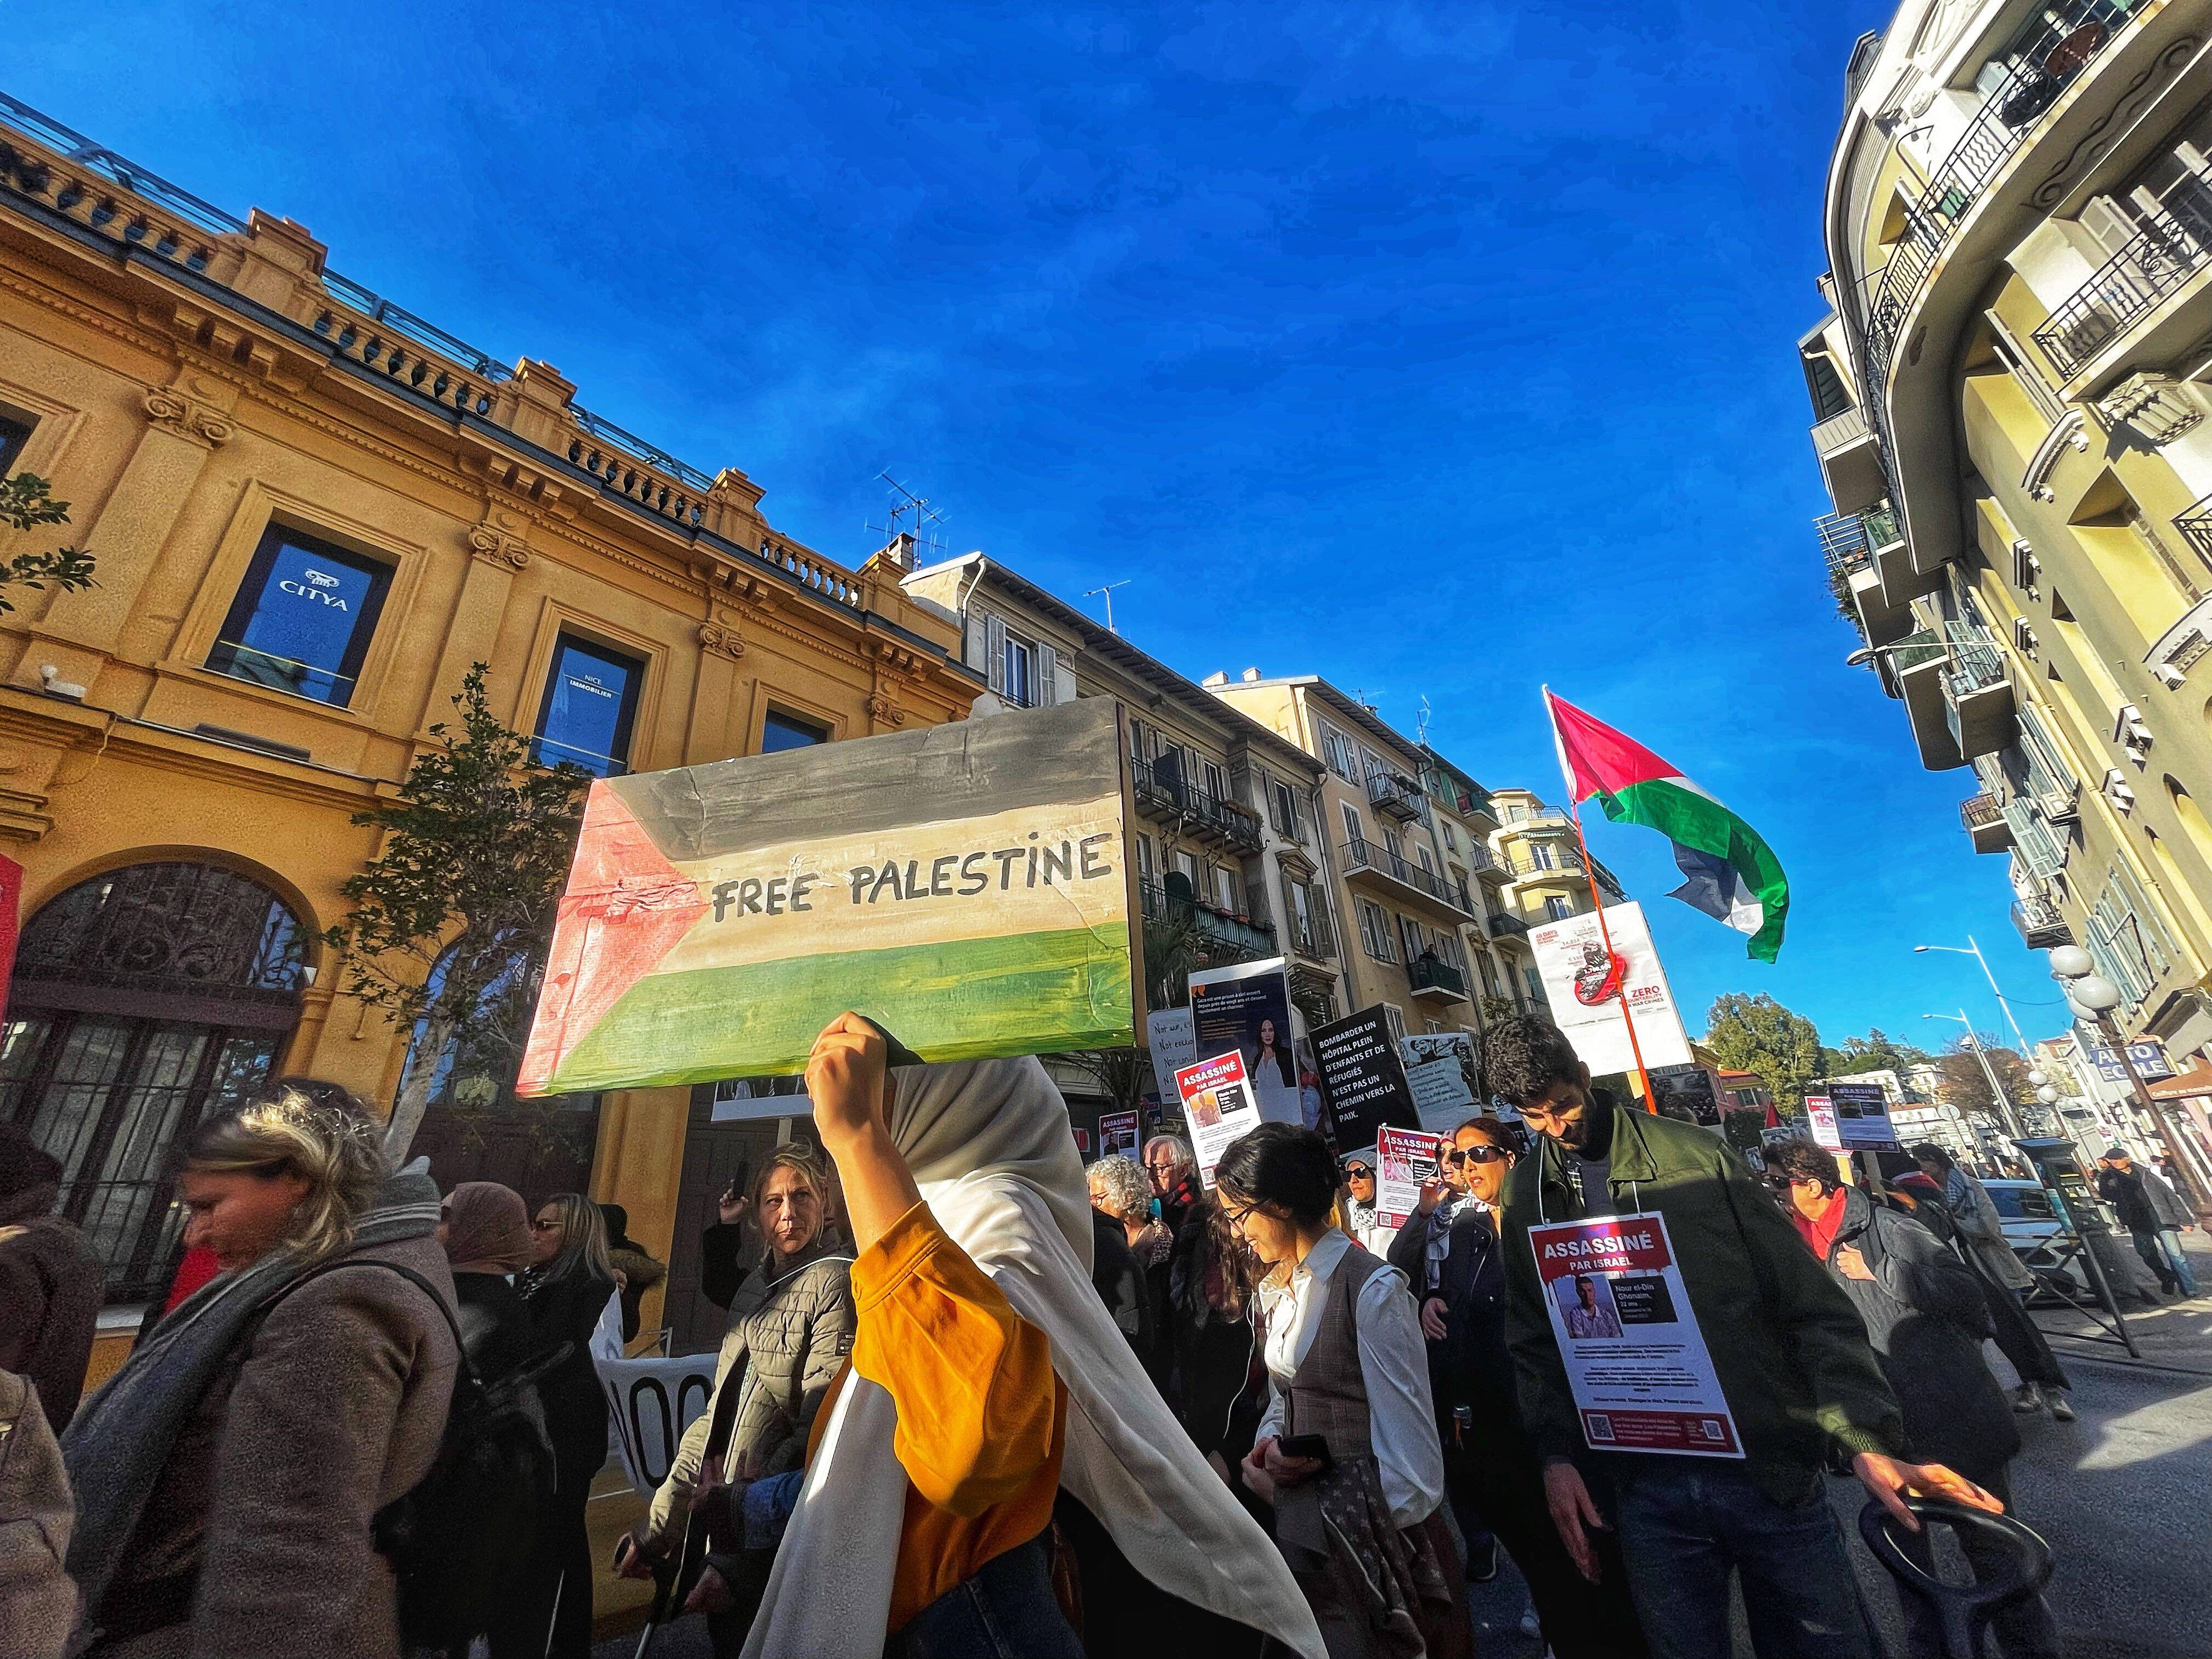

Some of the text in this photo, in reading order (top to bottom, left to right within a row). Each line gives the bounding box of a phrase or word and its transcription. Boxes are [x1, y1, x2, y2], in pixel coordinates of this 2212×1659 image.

[279, 579, 348, 612] CITYA
[569, 680, 612, 699] IMMOBILIER
[585, 674, 602, 686] NICE
[712, 873, 819, 923] FREE
[1631, 986, 1660, 997] ZERO
[1154, 1023, 1167, 1035] Not
[1319, 1020, 1376, 1048] BOMBARDER UN
[1159, 1039, 1172, 1051] Not
[1322, 1036, 1373, 1060] HÔPITAL PLEIN
[1163, 1057, 1176, 1068] Not
[1325, 1044, 1385, 1073] D'ENFANTS ET DE
[1163, 1075, 1175, 1086] No
[1183, 1060, 1238, 1087] ASSASSINÉ
[1329, 1066, 1362, 1085] RÉFUGIÉS
[1196, 1076, 1228, 1091] PAR ISRAEL
[1332, 1074, 1380, 1097] N'EST PAS UN
[1336, 1084, 1396, 1109] CHEMIN VERS LA
[1339, 1111, 1358, 1122] PAIX.
[1384, 1136, 1437, 1151] ASSASSINÉ
[1544, 1230, 1654, 1259] ASSASSINÉ
[1570, 1256, 1633, 1271] PAR ISRAEL
